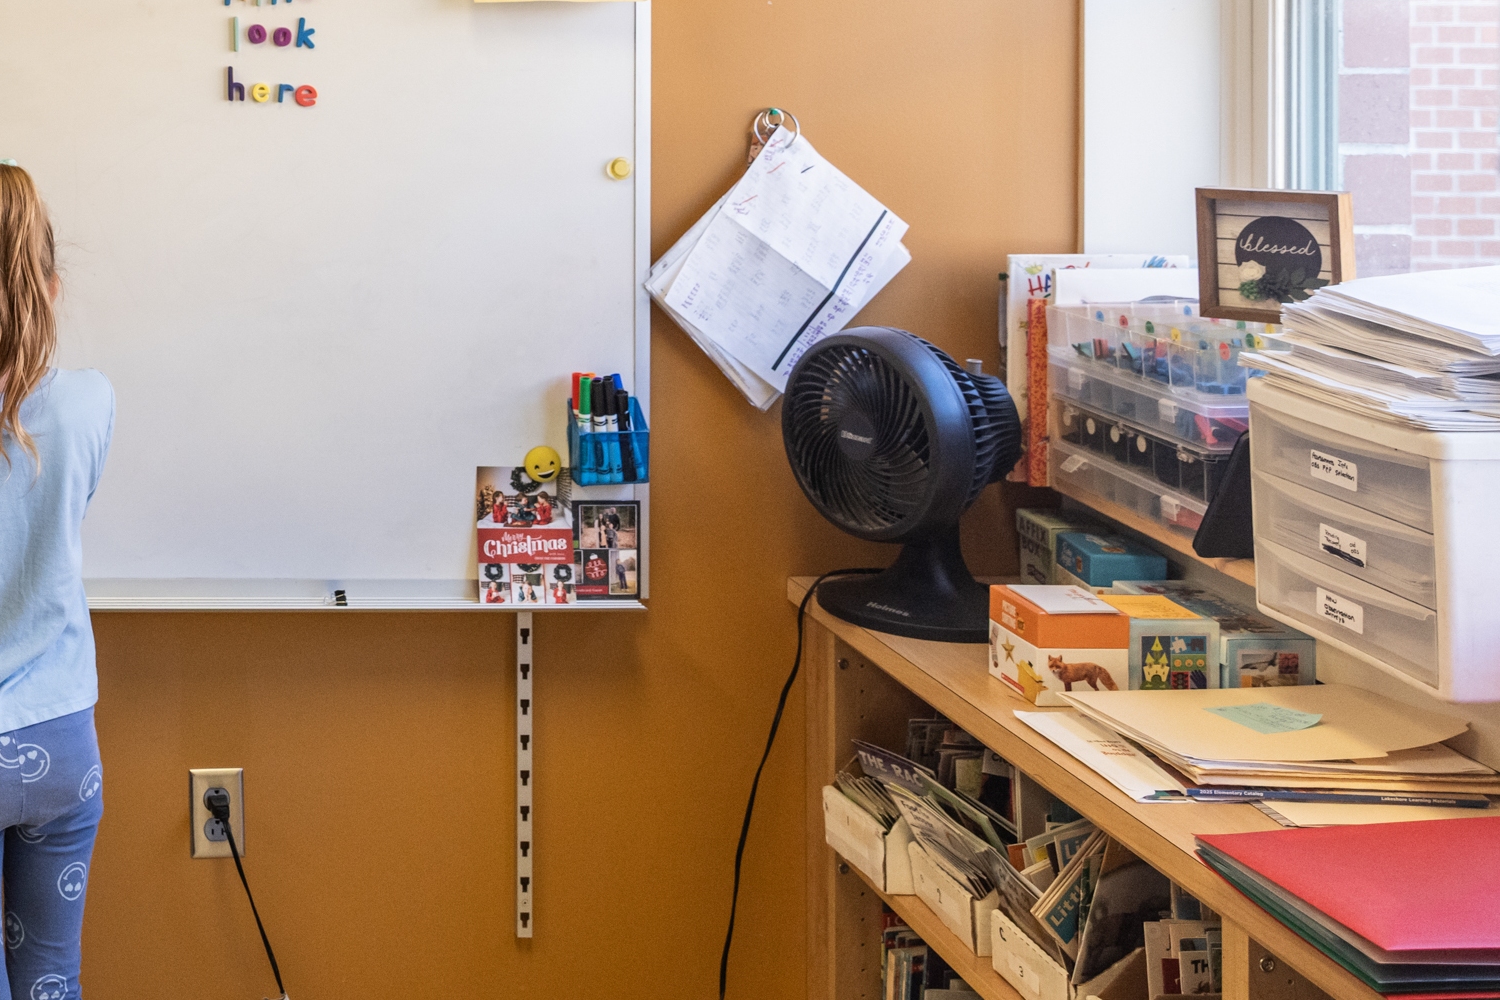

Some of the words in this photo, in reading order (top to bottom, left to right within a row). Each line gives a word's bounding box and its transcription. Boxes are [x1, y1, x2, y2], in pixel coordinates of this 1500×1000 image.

[233, 16, 315, 52] look
[227, 66, 318, 107] here
[1240, 233, 1316, 256] blessed
[483, 535, 567, 558] Christmas
[858, 750, 887, 773] THE
